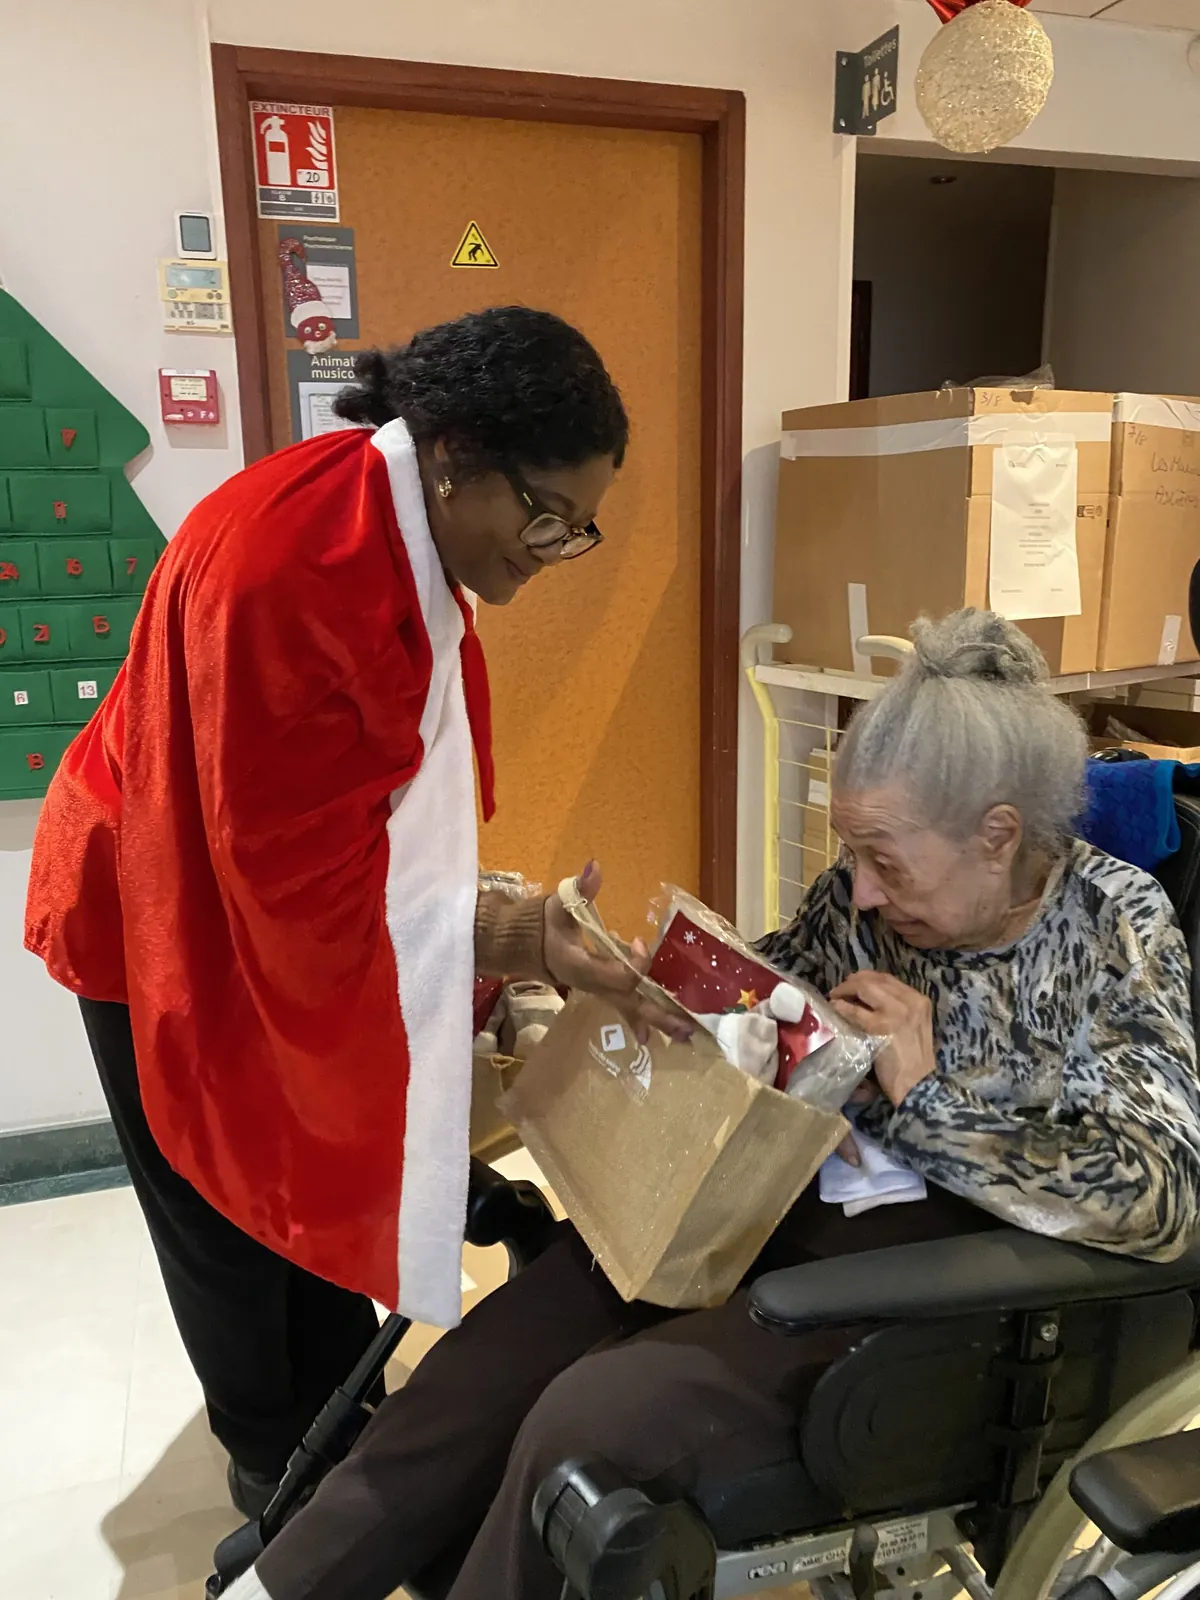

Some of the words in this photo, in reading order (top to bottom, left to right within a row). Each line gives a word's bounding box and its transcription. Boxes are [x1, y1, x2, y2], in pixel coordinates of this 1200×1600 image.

[252, 101, 330, 116] EXTINCTEUR
[306, 171, 320, 183] 20
[310, 355, 356, 367] Animat
[311, 367, 355, 379] musico
[125, 557, 138, 575] 7
[79, 684, 96, 697] 13
[16, 692, 26, 704] 6
